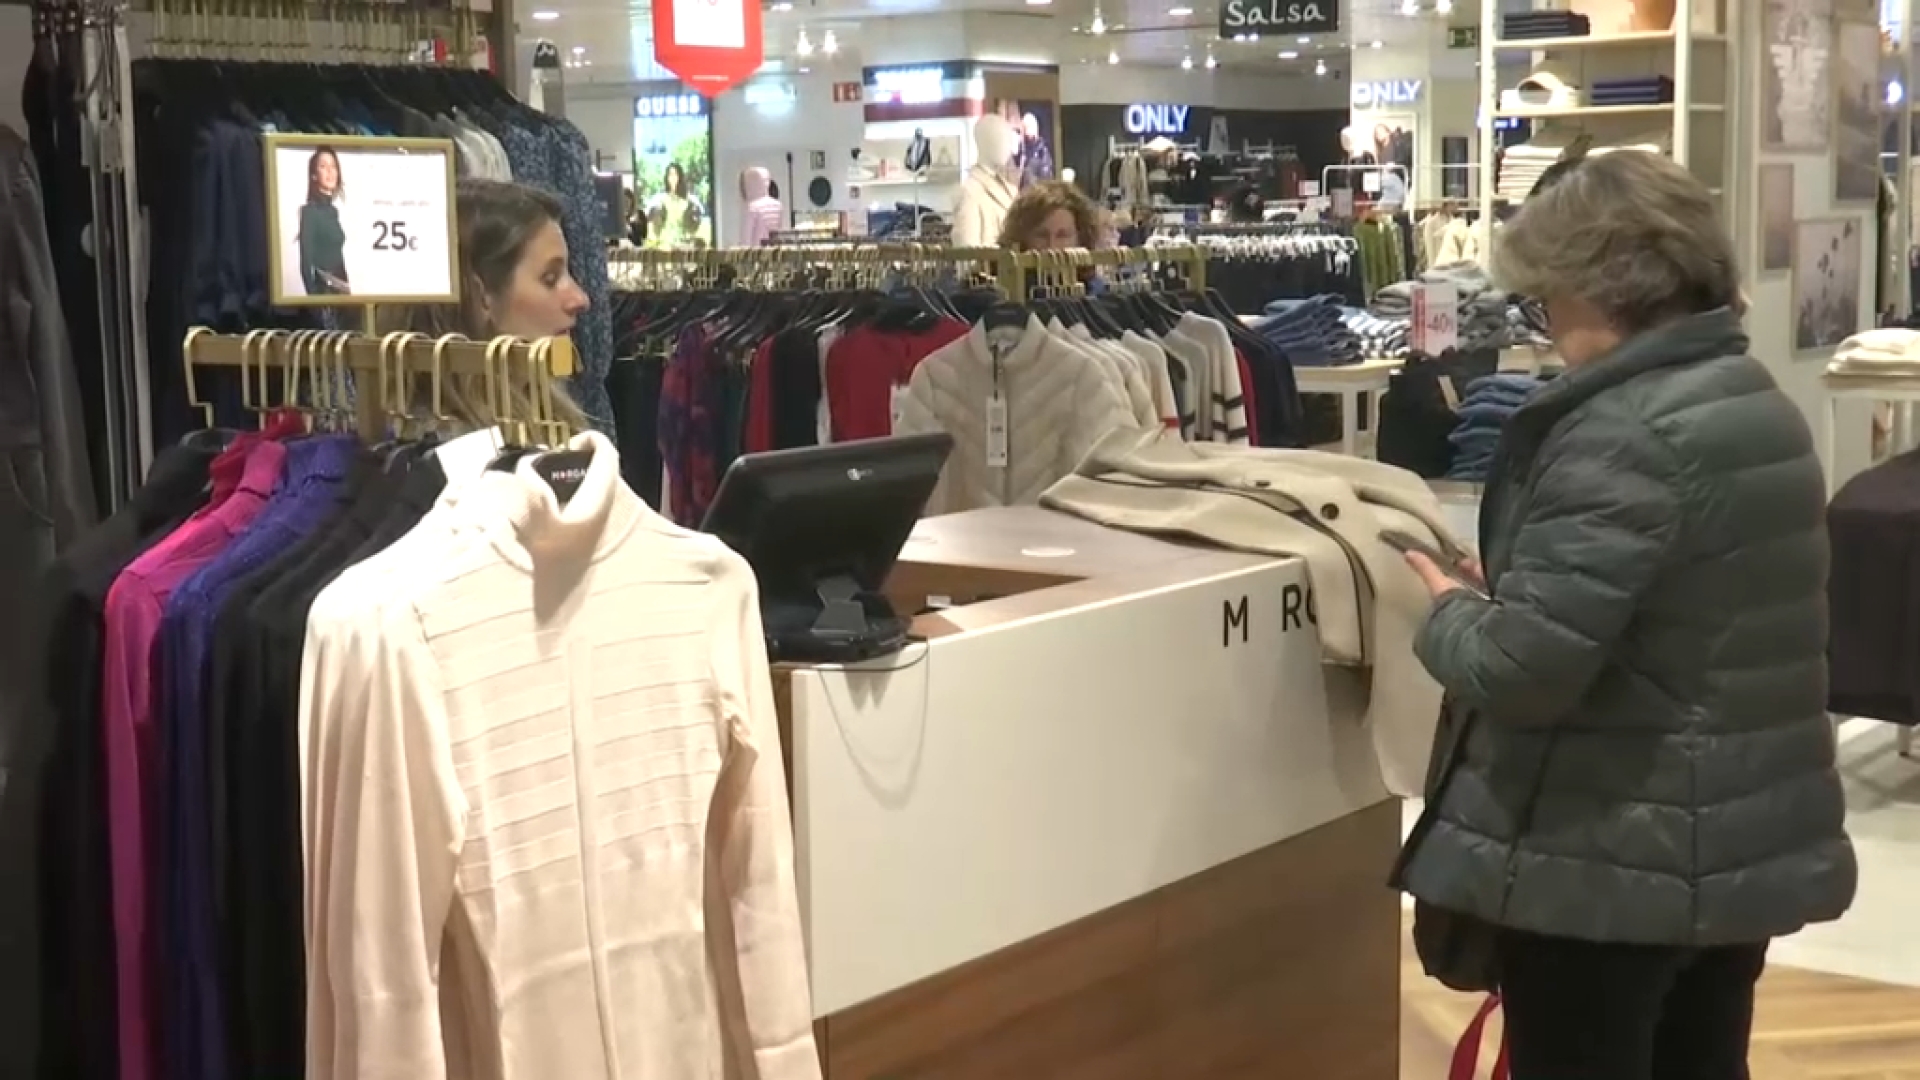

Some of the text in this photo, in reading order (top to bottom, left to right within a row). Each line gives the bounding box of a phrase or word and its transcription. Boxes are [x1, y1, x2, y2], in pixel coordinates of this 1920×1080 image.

[1225, 0, 1326, 26] Salsa
[1347, 80, 1421, 103] ONLY
[1126, 104, 1189, 133] ONLY
[372, 220, 419, 251] 25€
